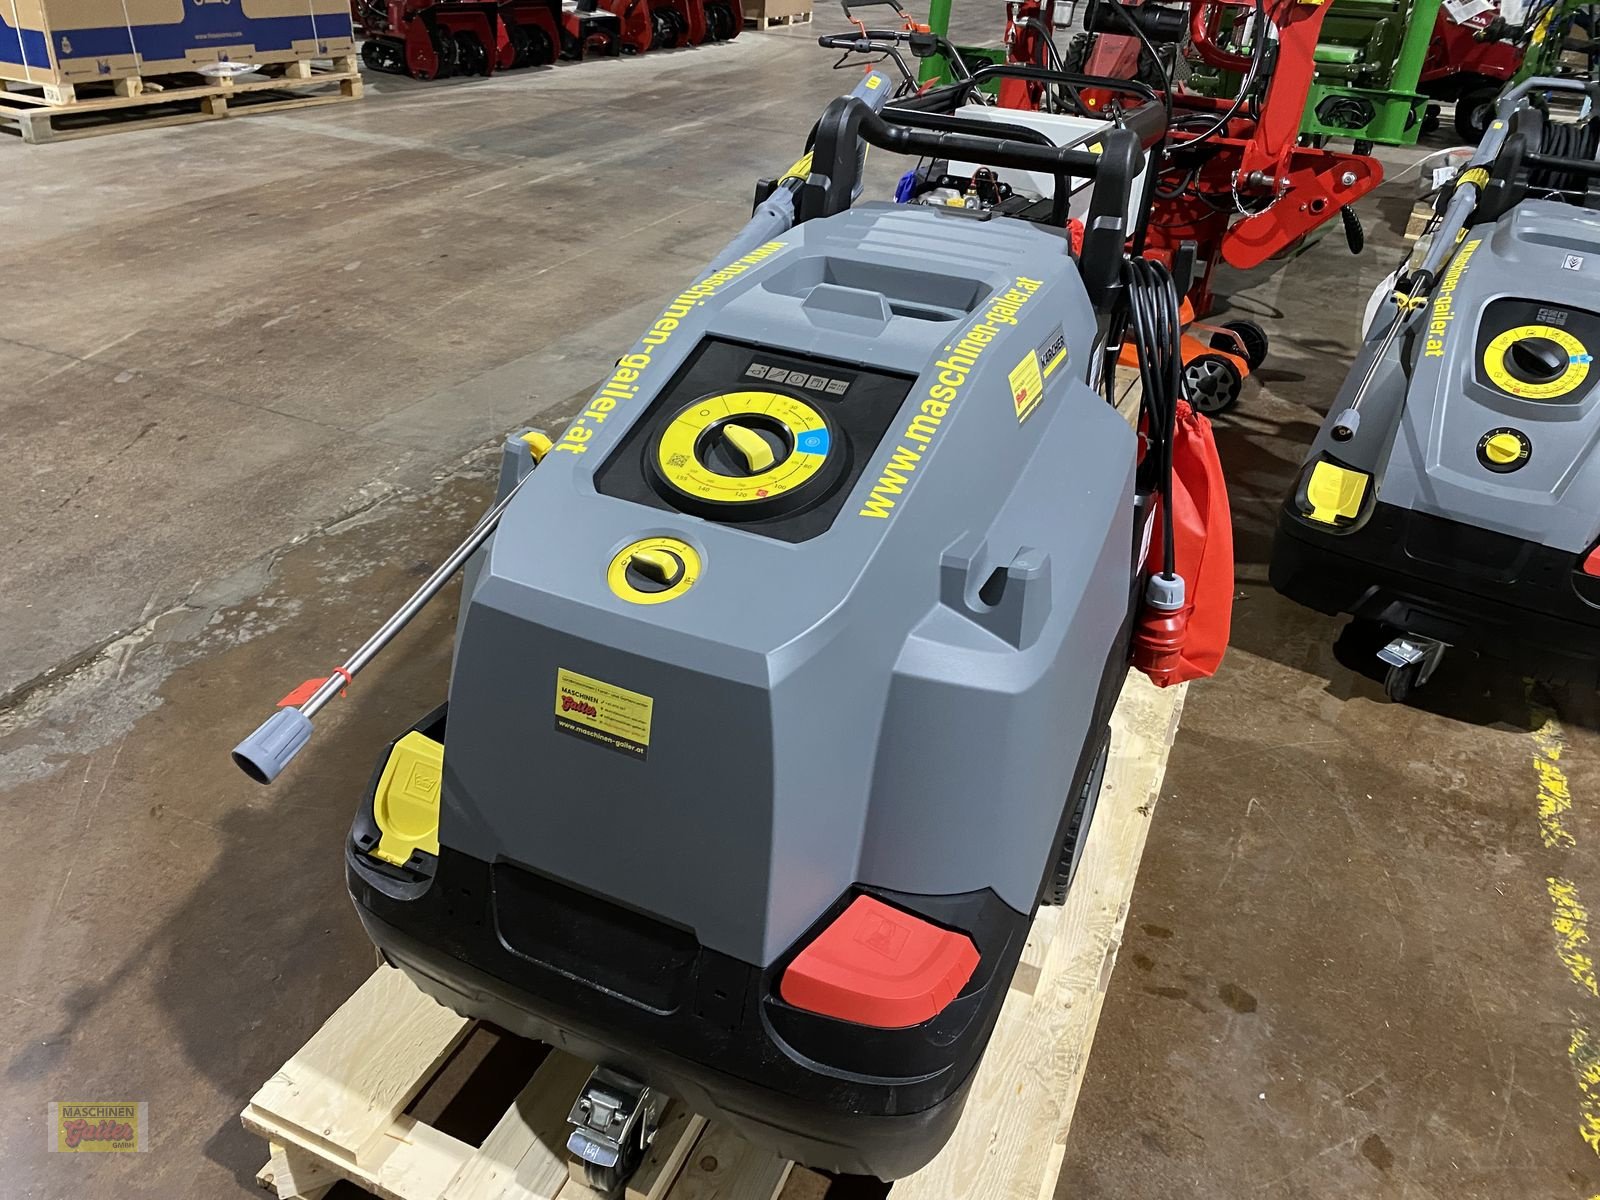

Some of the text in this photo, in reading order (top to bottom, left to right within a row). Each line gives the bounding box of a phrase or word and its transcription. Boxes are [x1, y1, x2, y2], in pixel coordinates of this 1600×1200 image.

[560, 241, 789, 454] www.maschinen-gailer.at
[858, 276, 1045, 520] www.maschinen-gailer.at
[561, 686, 599, 704] MASCHINEN
[561, 694, 597, 717] Gailer
[558, 720, 645, 754] www.maschinen-gailer.at
